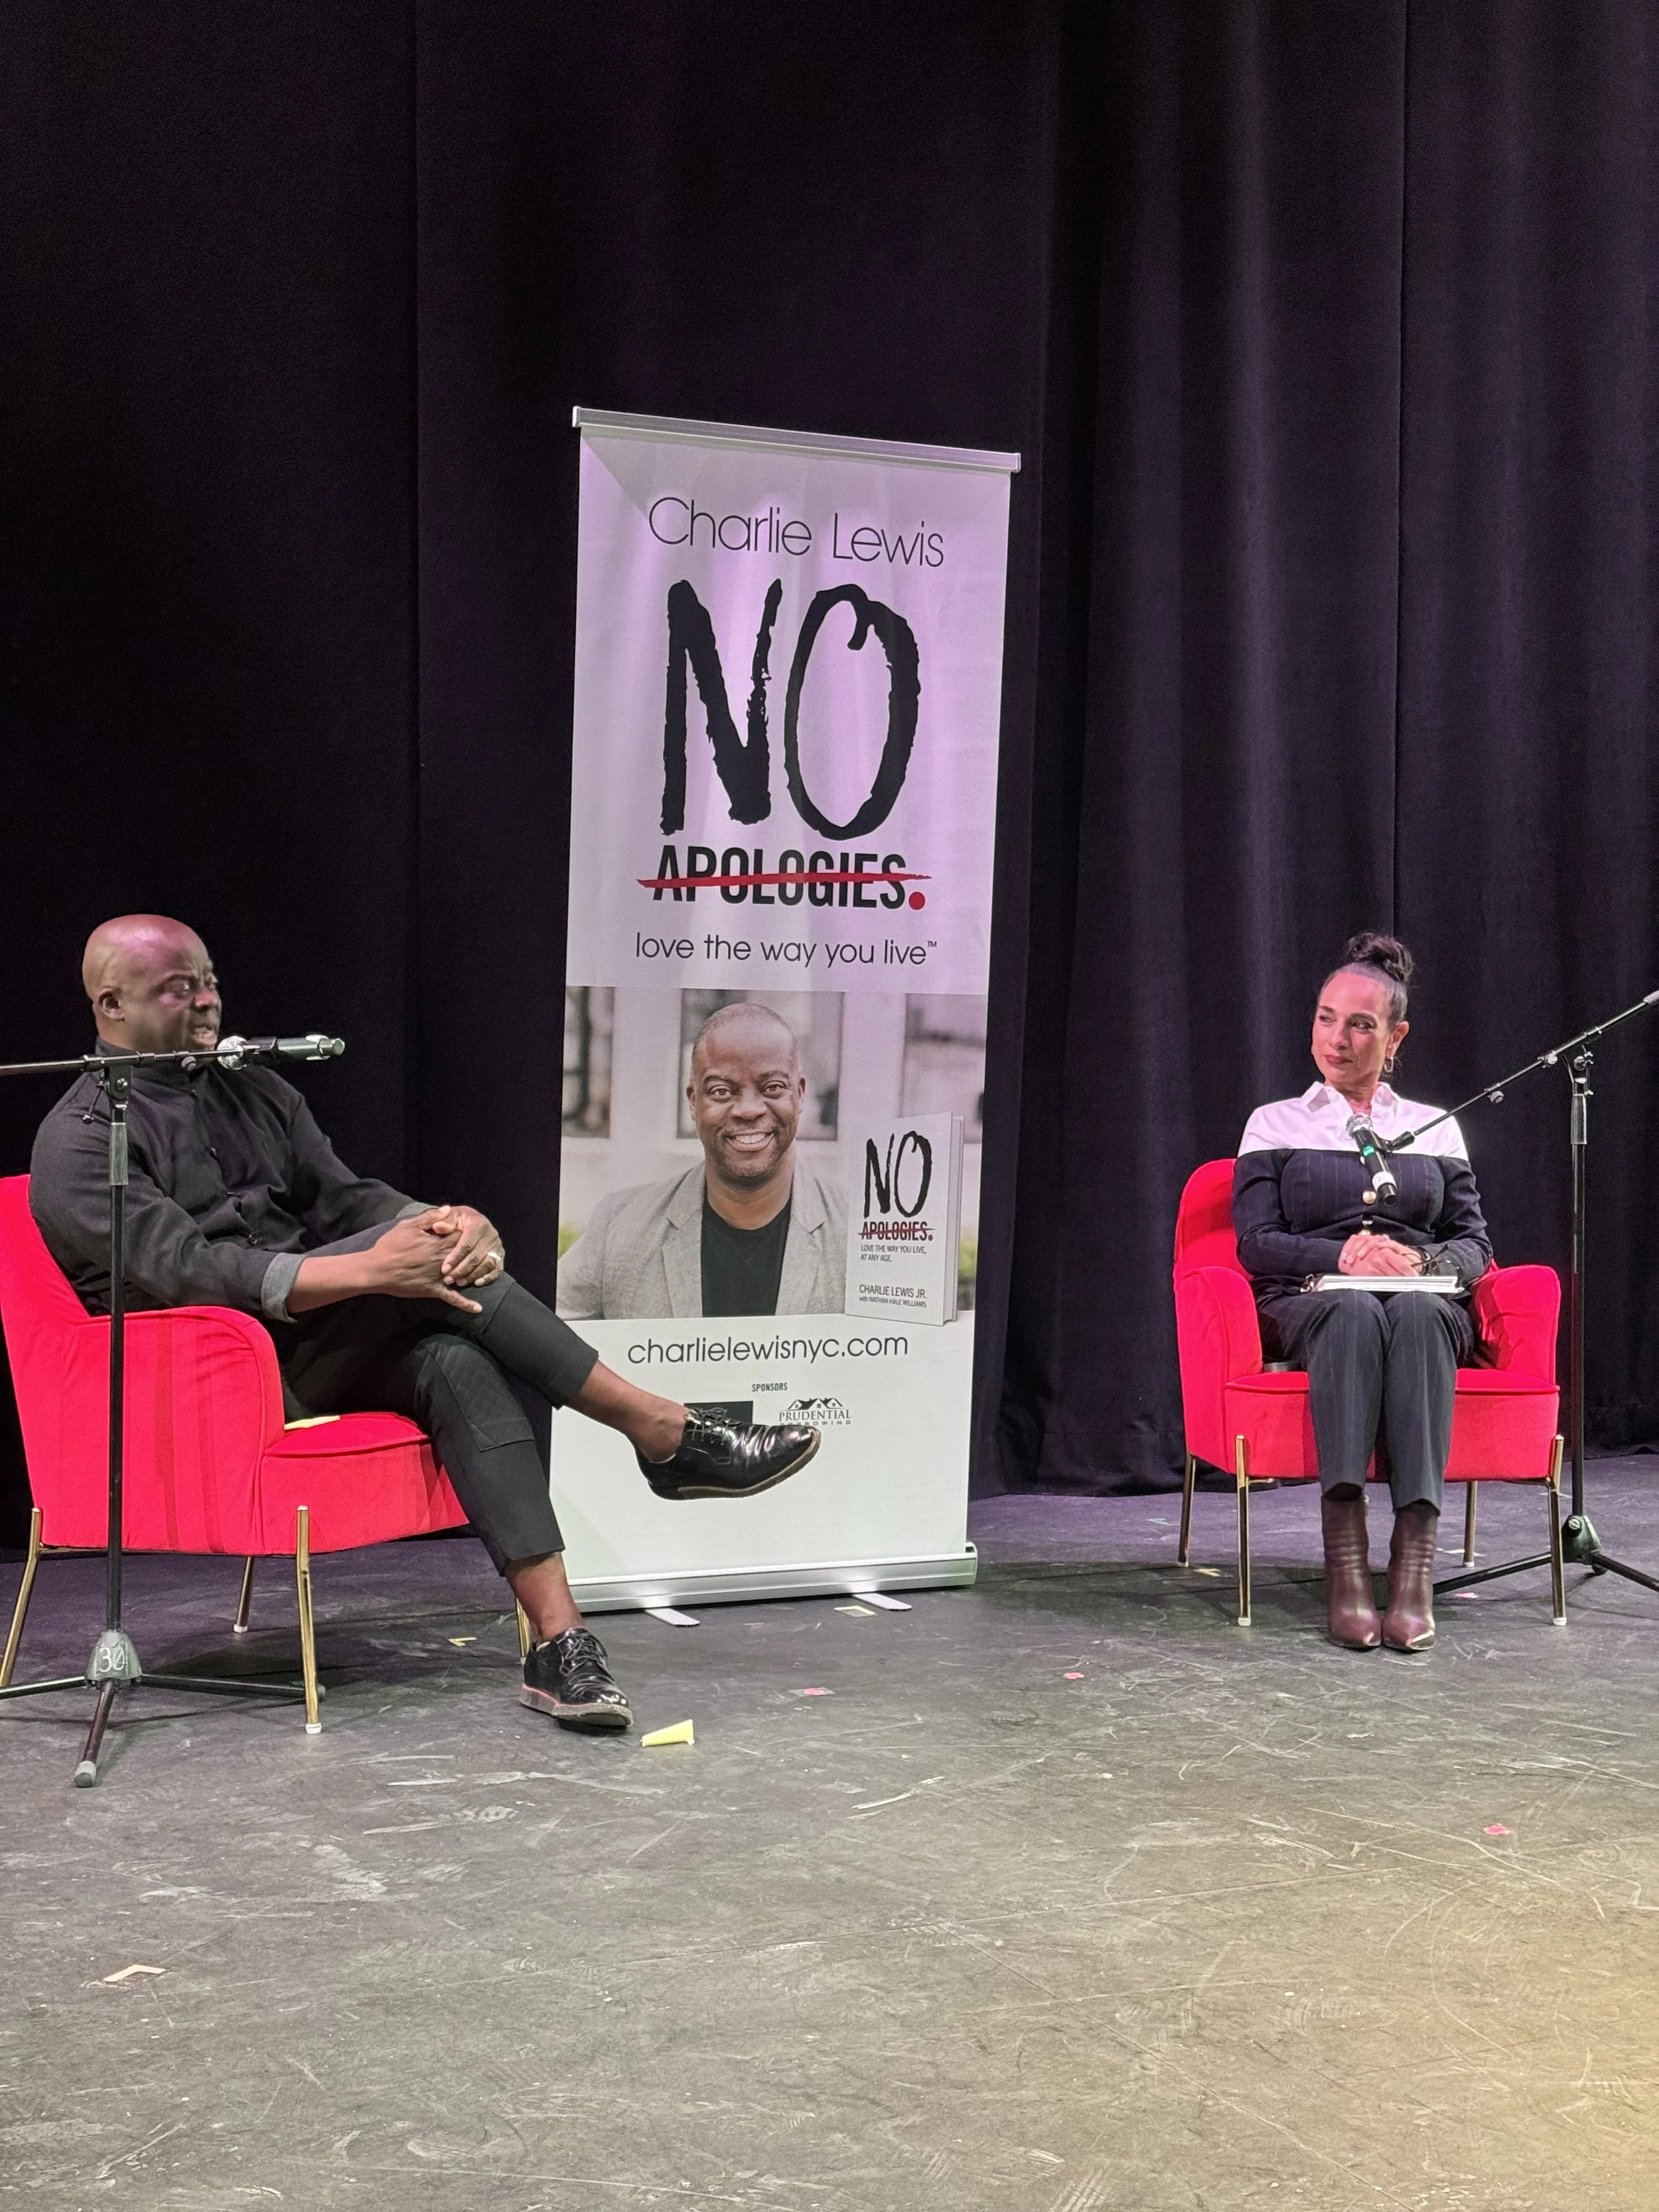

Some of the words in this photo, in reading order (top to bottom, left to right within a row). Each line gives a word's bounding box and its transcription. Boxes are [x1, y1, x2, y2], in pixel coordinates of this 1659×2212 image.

[648, 496, 812, 555] Charlie
[833, 512, 944, 567] Lewis
[660, 578, 921, 841] NO
[653, 845, 926, 911] APOLOGIES.
[636, 932, 694, 959] love
[703, 934, 751, 960] the
[760, 941, 816, 968] way
[825, 942, 874, 968] you
[863, 1131, 932, 1218] NO
[859, 1284, 891, 1296] CHARLIE
[891, 1287, 914, 1298] LEWIS
[915, 1289, 928, 1299] JR.
[902, 1299, 927, 1308] WILLIAMS
[627, 1335, 908, 1364] charlielewisnyc.com
[752, 1382, 788, 1392] SPONSORS
[779, 1409, 852, 1422] PRUDENTIAL
